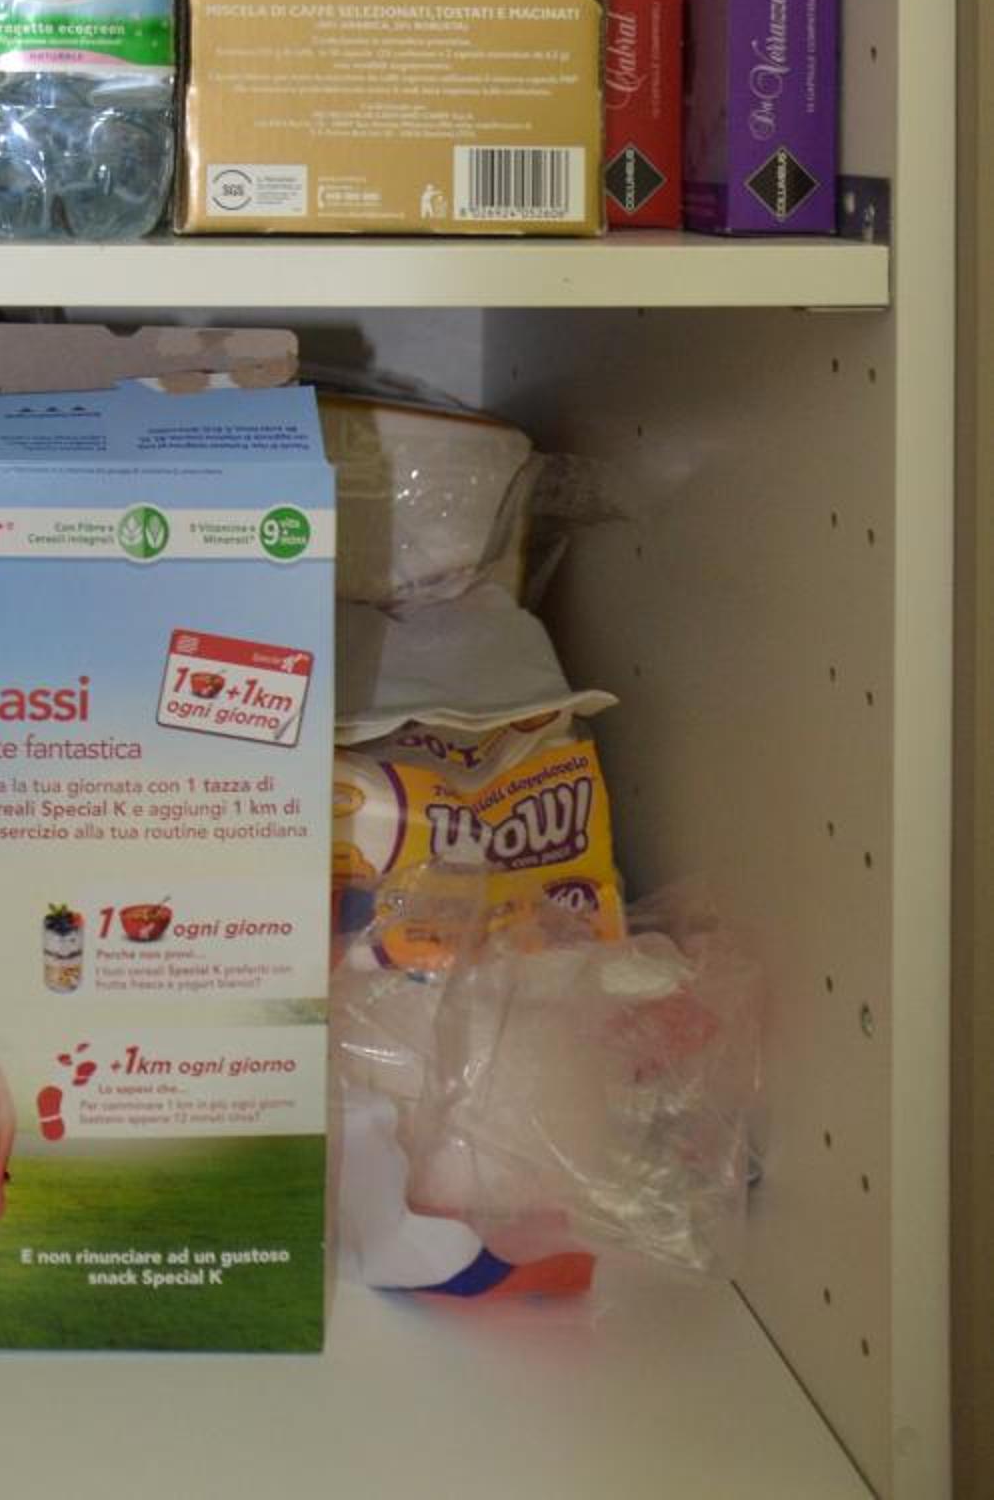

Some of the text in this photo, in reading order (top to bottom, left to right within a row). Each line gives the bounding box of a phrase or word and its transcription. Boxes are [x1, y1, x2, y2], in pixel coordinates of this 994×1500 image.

[262, 519, 279, 545] 9
[166, 700, 281, 730] ogni giorno
[25, 733, 143, 760] fantastica
[12, 777, 27, 794] la
[33, 779, 62, 794] tua
[68, 778, 143, 799] giornata
[147, 780, 181, 793] con
[187, 777, 196, 793] 1
[203, 778, 251, 793] tazza
[256, 775, 275, 792] di
[41, 800, 107, 820] Special
[114, 800, 127, 816] K
[132, 803, 144, 816] e
[149, 800, 228, 821] aggiungi
[234, 799, 242, 815] 1
[250, 799, 277, 815] km
[284, 798, 301, 815] di
[73, 822, 104, 840] alla
[111, 825, 140, 840] tua
[145, 823, 208, 840] routine
[213, 821, 308, 842] quotidiana
[173, 920, 220, 940] ogni
[224, 919, 294, 939] giorno
[178, 1057, 224, 1077] ogni
[229, 1057, 297, 1077] giorno
[20, 1247, 291, 1267] E non rinunciare ad un gustoso
[88, 1268, 223, 1289] snack Special K
